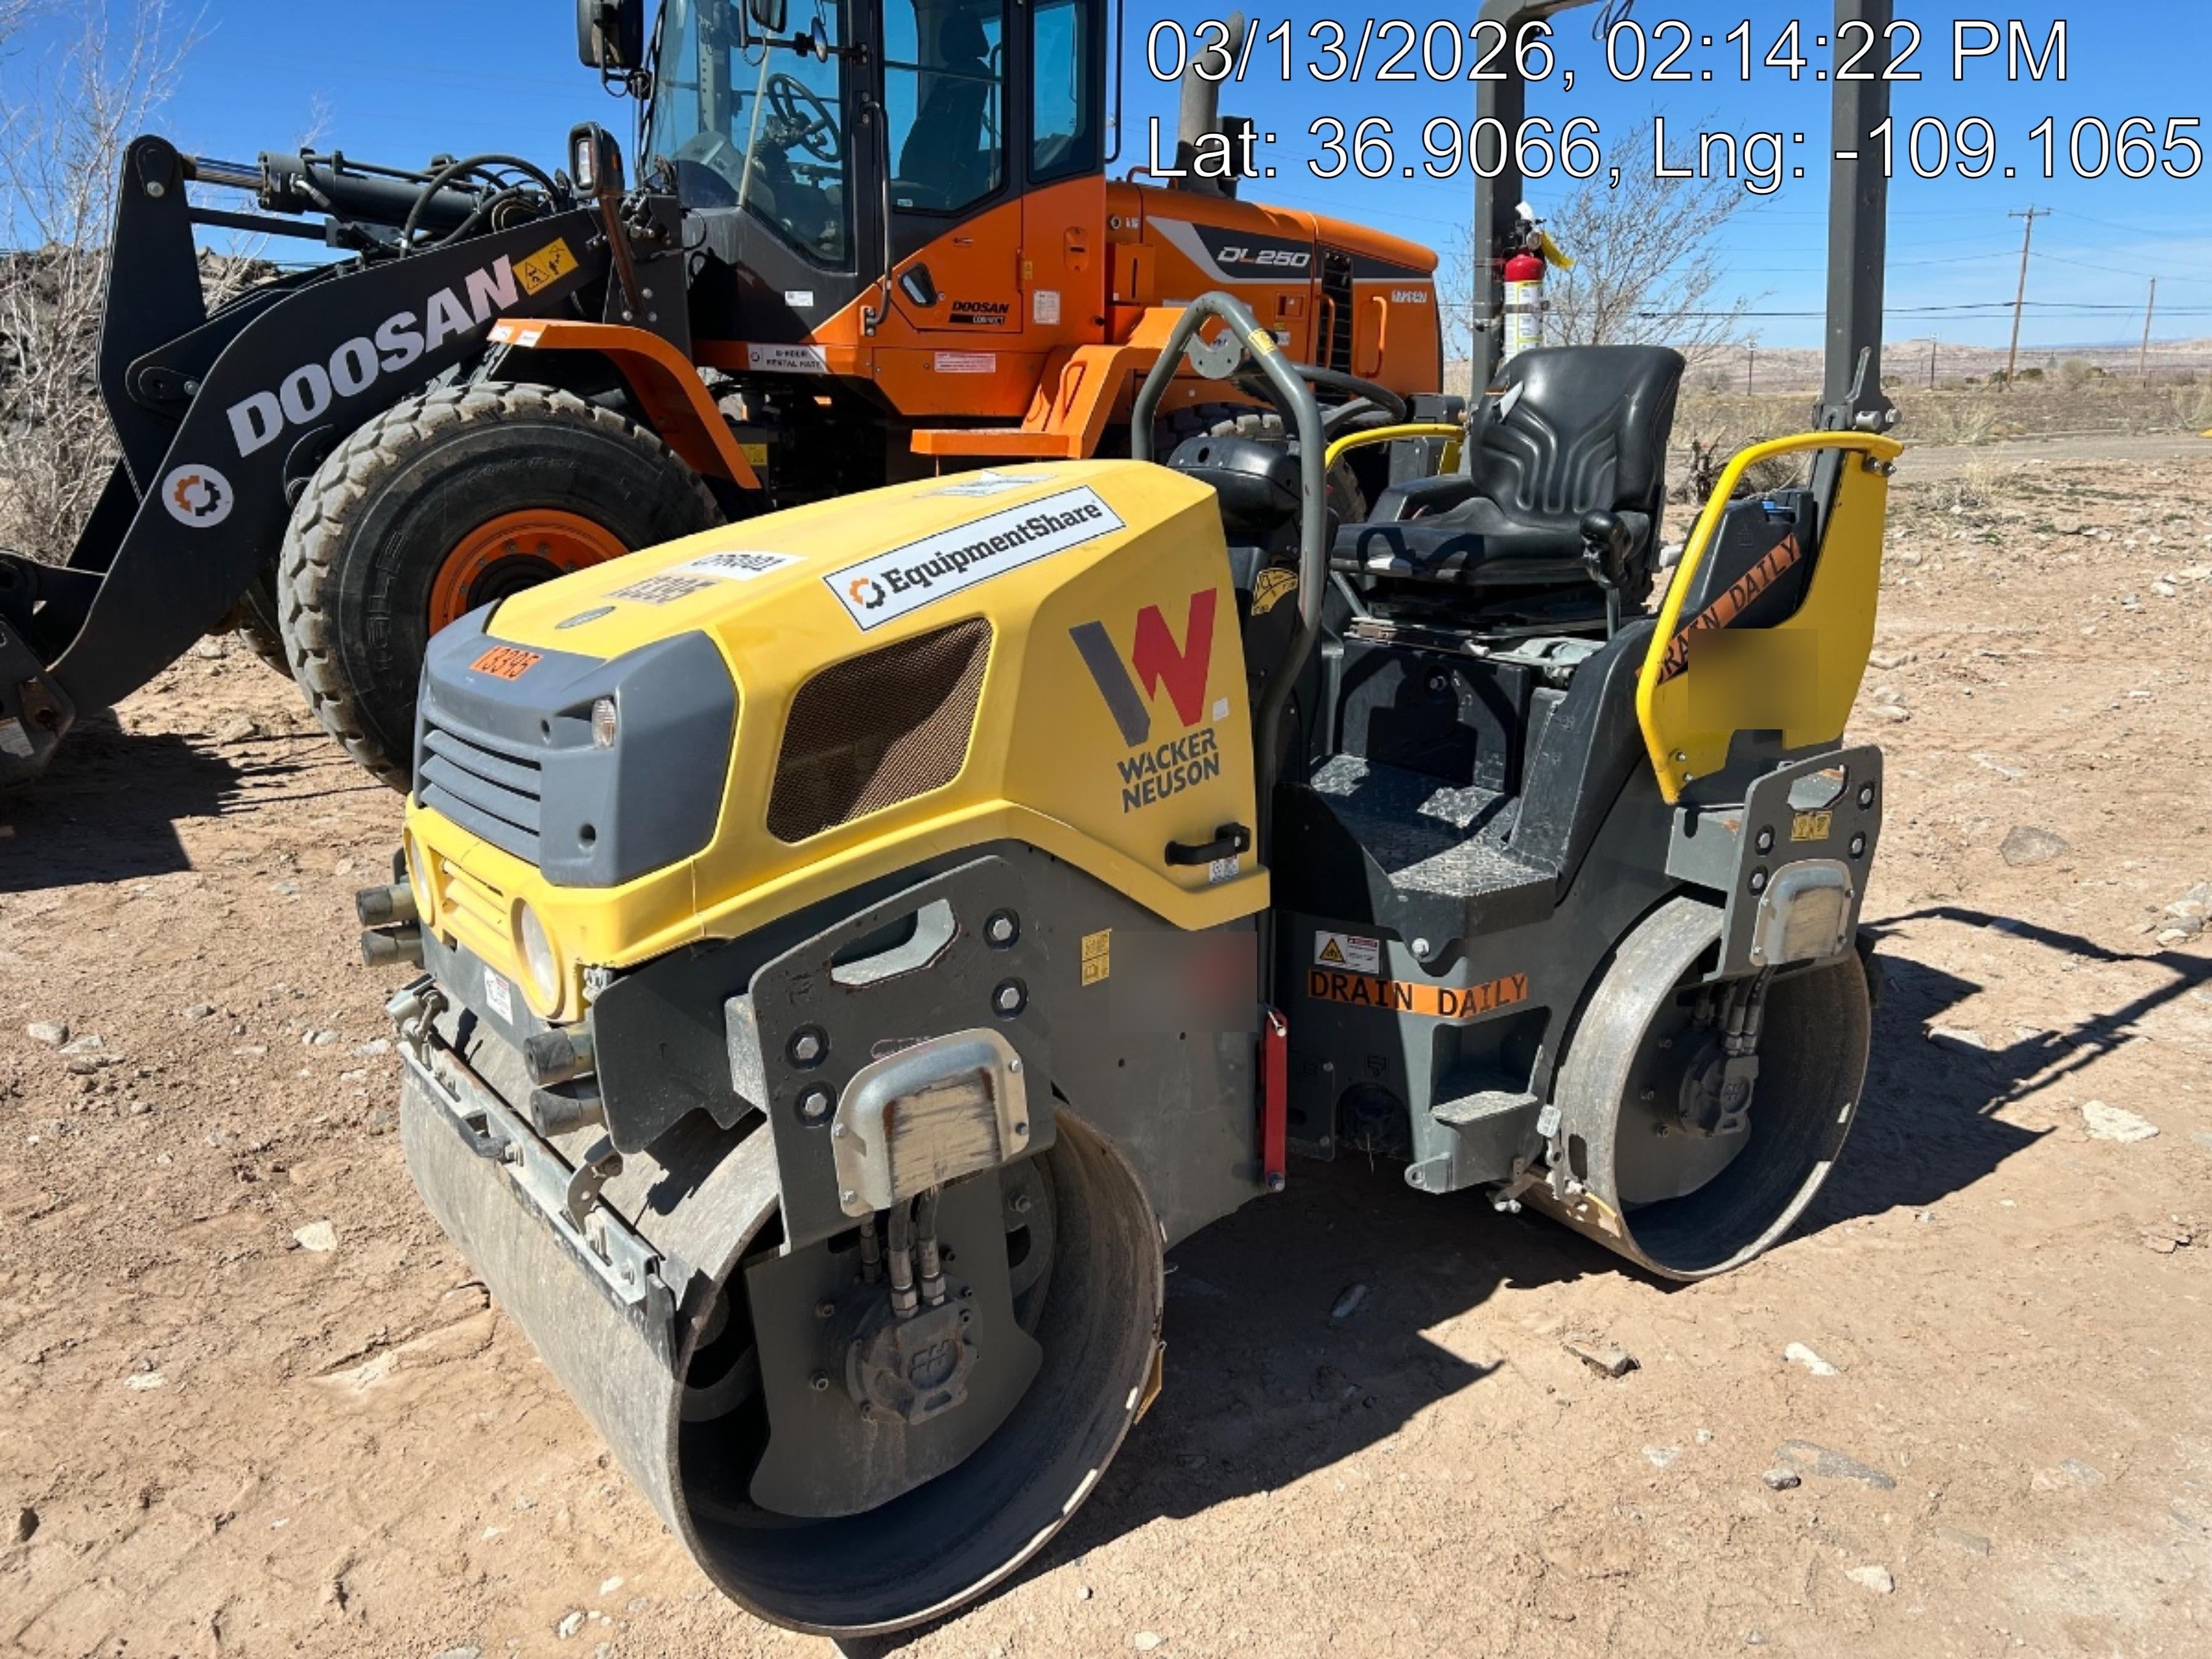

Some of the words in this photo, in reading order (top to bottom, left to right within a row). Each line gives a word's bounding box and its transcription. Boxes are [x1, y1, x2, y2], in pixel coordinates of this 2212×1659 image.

[1217, 246, 1311, 268] DL250
[952, 300, 1010, 313] DOOSAN
[226, 253, 519, 458] DOOSAN
[880, 501, 1104, 594] EquipmentShare
[1728, 532, 1795, 612] DAILY
[1116, 728, 1218, 784] WACKER
[1122, 751, 1220, 814] NEUSON
[1311, 971, 1413, 1011] DRAIN
[1438, 973, 1526, 1018] DAILY
